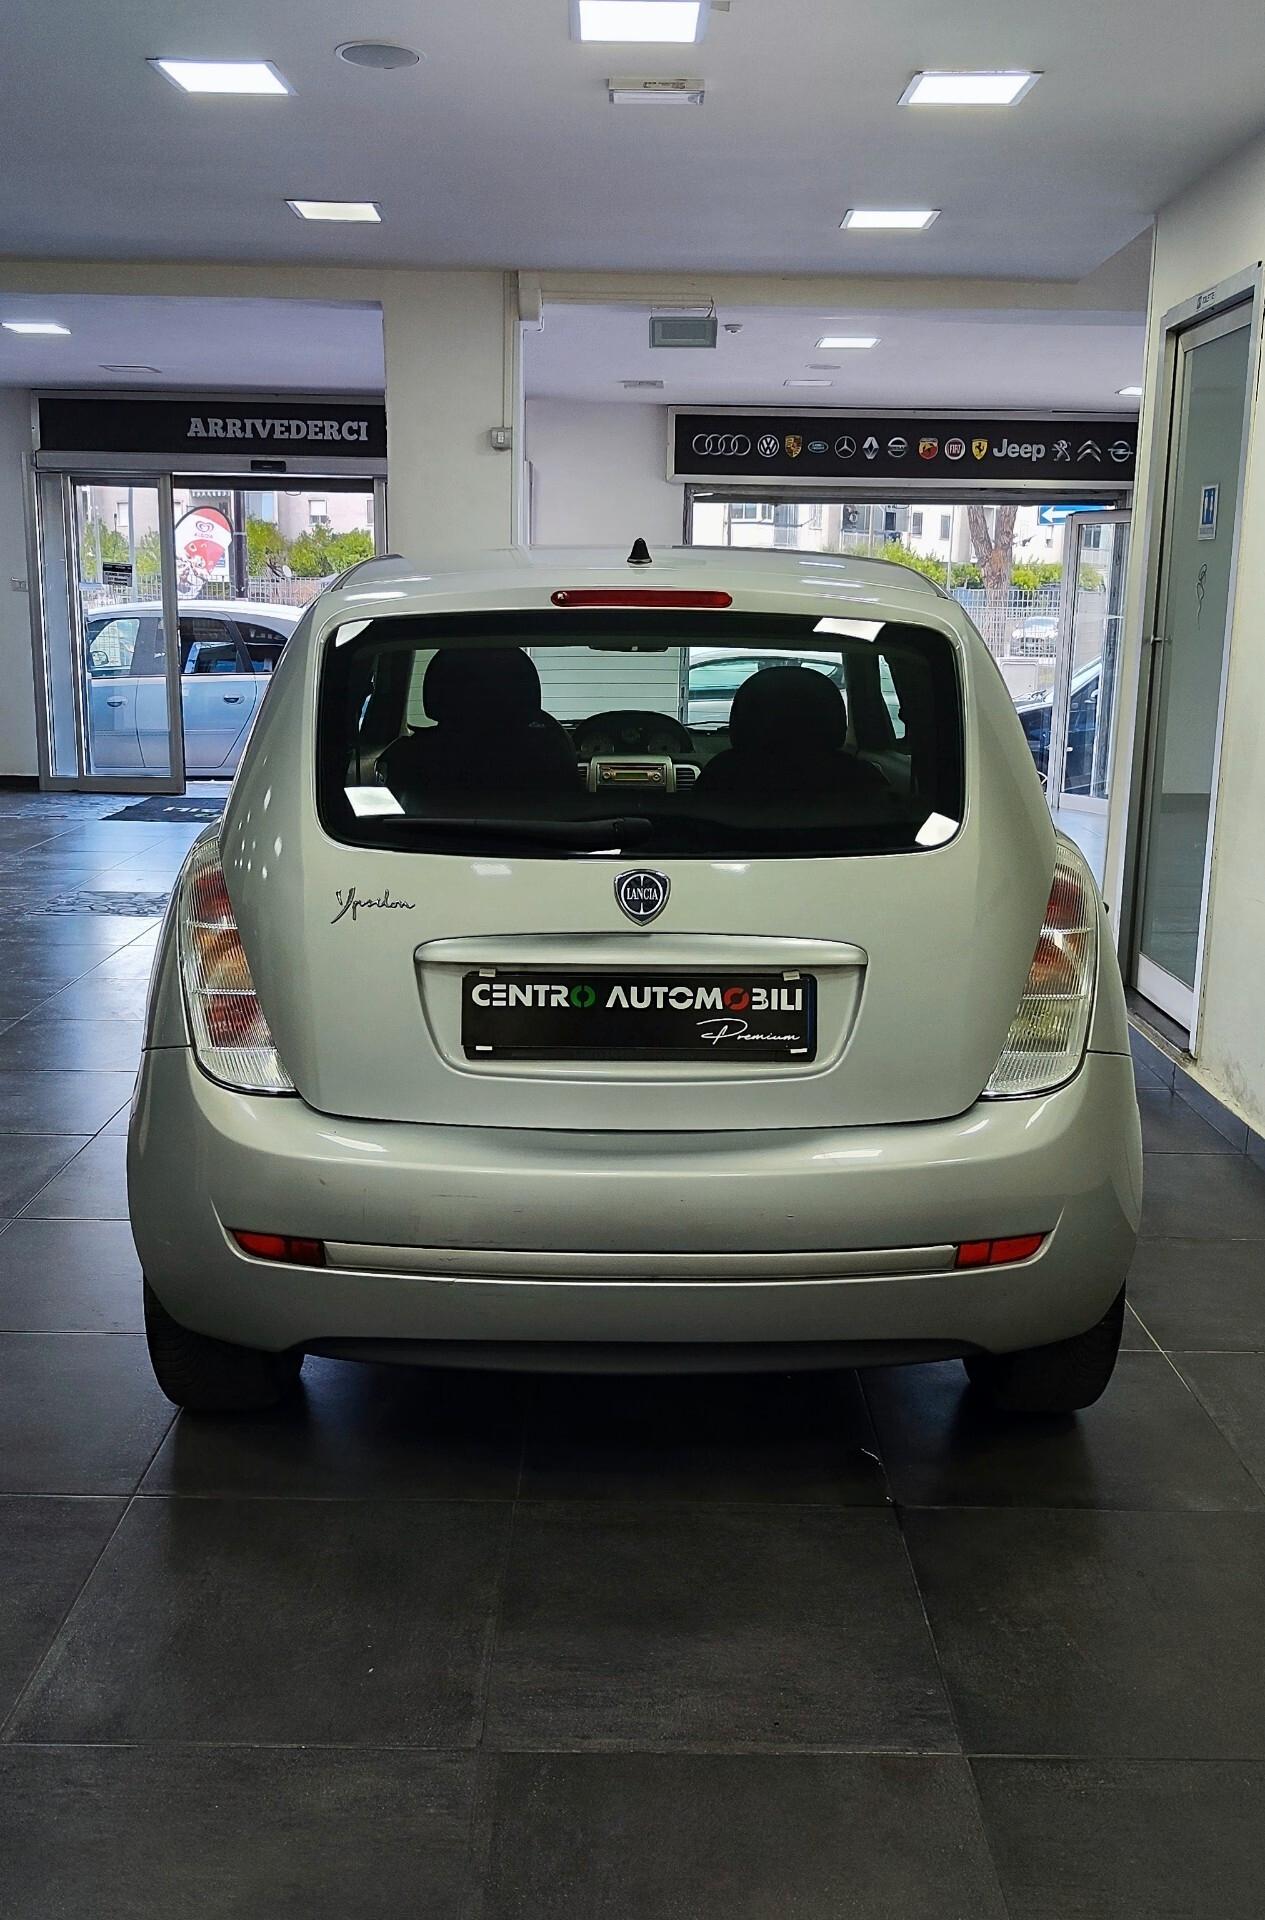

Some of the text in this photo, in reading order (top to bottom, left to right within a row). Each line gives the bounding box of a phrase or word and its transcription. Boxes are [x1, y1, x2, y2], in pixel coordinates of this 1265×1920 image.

[187, 417, 368, 441] ARRIVEDERCI
[992, 438, 1046, 462] Jeep
[330, 886, 416, 924] Ypsilon
[626, 887, 659, 901] LANCIA
[471, 983, 803, 1011] CENTRO AUTOMOBILI
[696, 1017, 801, 1045] Premium
